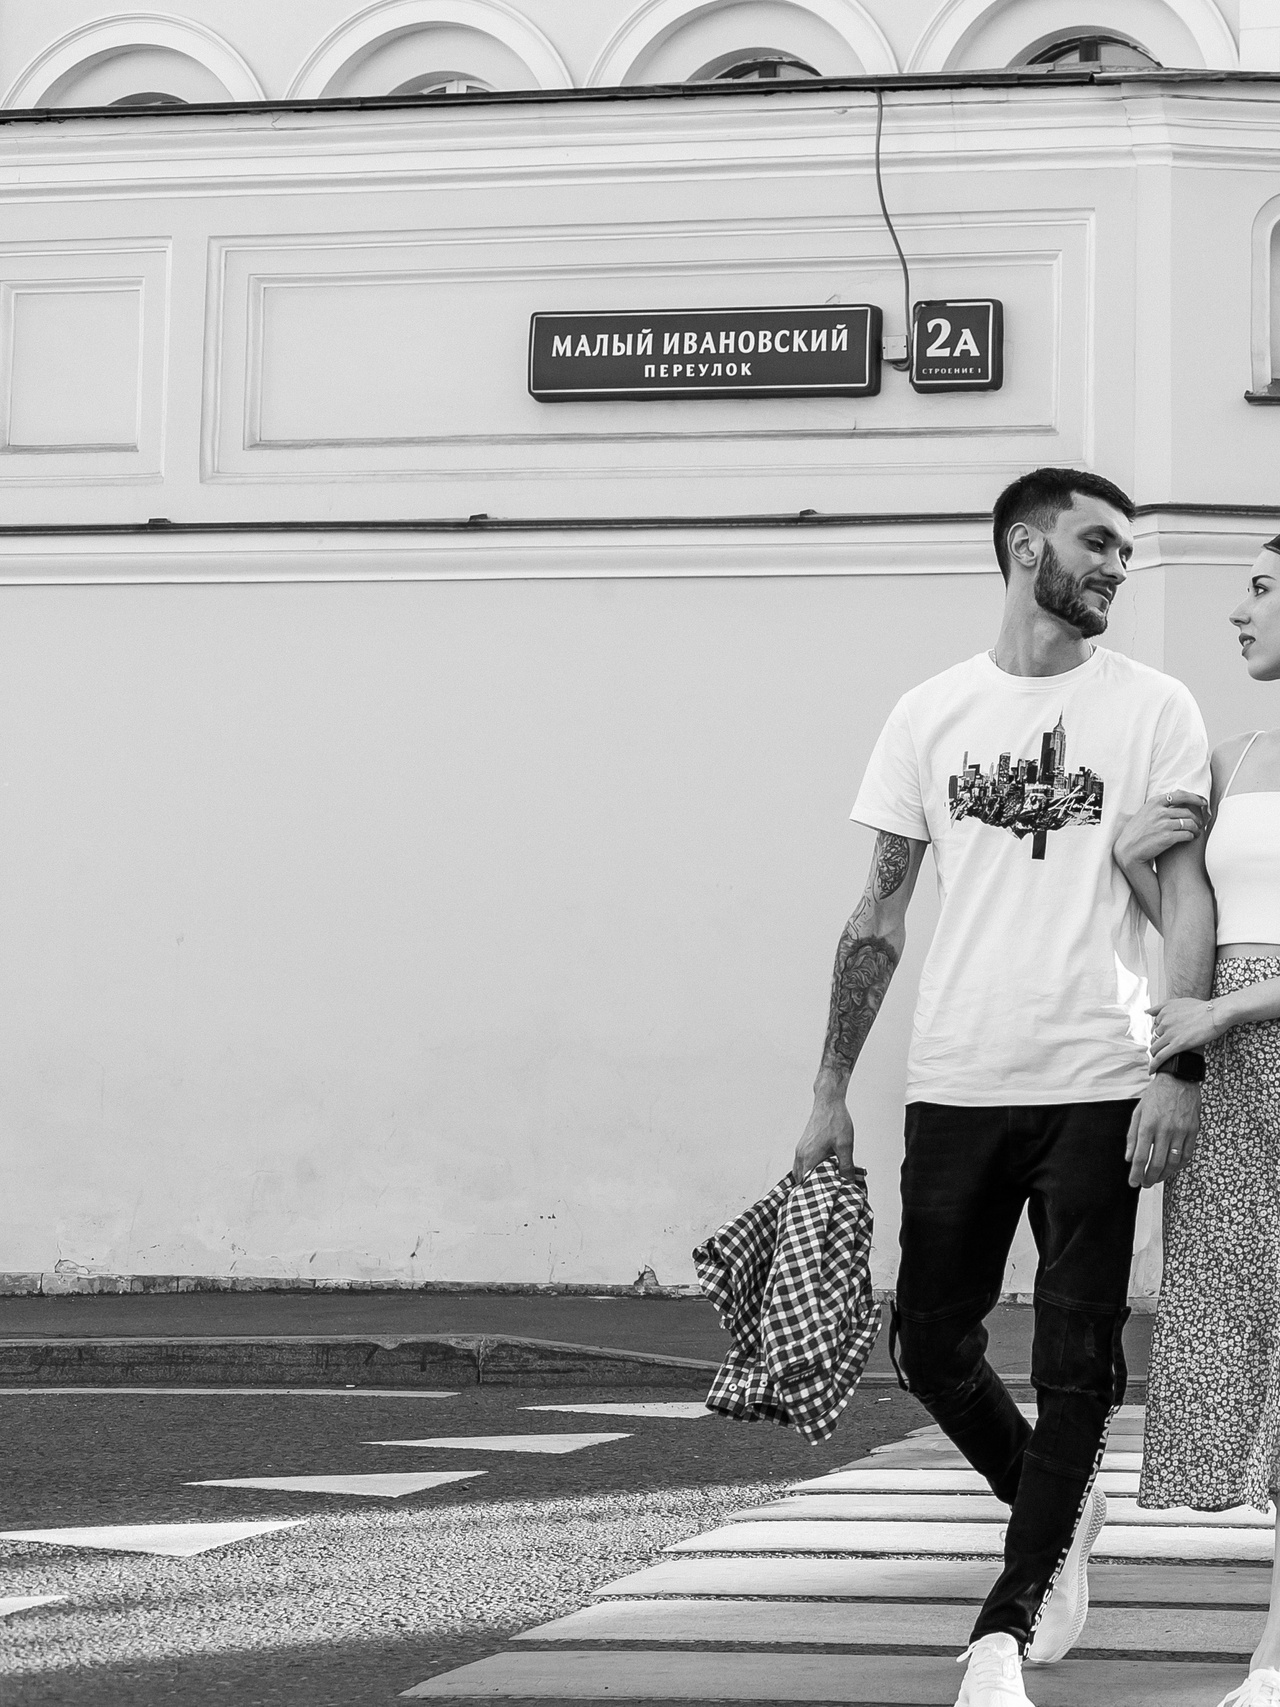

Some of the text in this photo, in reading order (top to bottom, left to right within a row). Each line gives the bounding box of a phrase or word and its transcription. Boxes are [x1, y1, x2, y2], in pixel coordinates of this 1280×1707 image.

[551, 323, 849, 358] МАЛЫЙ ИВАНОВСКИЙ
[926, 317, 981, 358] 2А
[644, 362, 752, 378] ПЕРЕУЛОК
[921, 367, 975, 375] СТРОЕНИЕ
